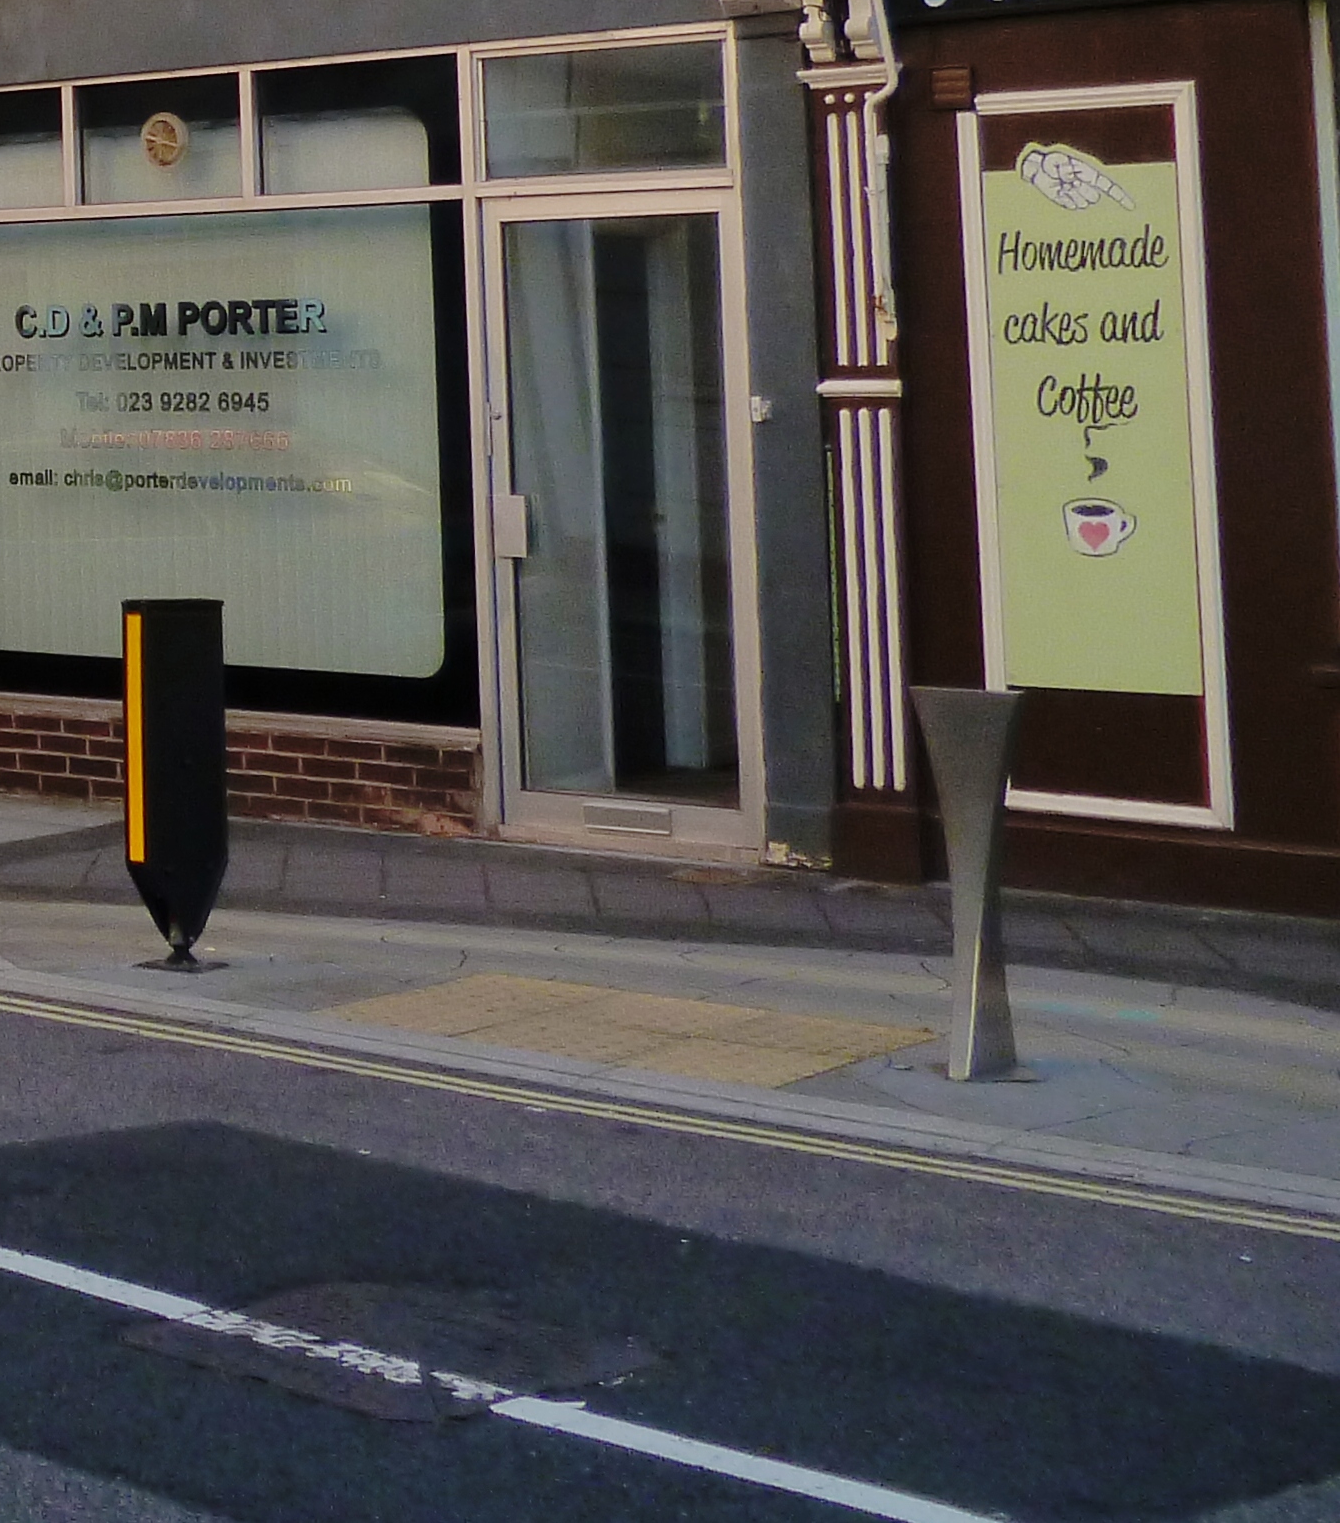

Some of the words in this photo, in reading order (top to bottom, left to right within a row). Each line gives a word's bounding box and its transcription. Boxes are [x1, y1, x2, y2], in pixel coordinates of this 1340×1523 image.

[998, 223, 1169, 275] Homemade
[15, 304, 70, 339] C.D
[78, 302, 105, 338] &
[111, 302, 168, 337] P.M
[177, 297, 327, 336] PORTER
[1004, 301, 1089, 346] cakes
[1100, 298, 1165, 344] and
[78, 351, 216, 371] DEVELOPMENT
[222, 351, 234, 370] &
[117, 391, 152, 412] 023
[160, 391, 211, 412] 9282
[218, 391, 270, 412] 6945
[1037, 373, 1139, 424] Coffee
[9, 469, 59, 487] email:
